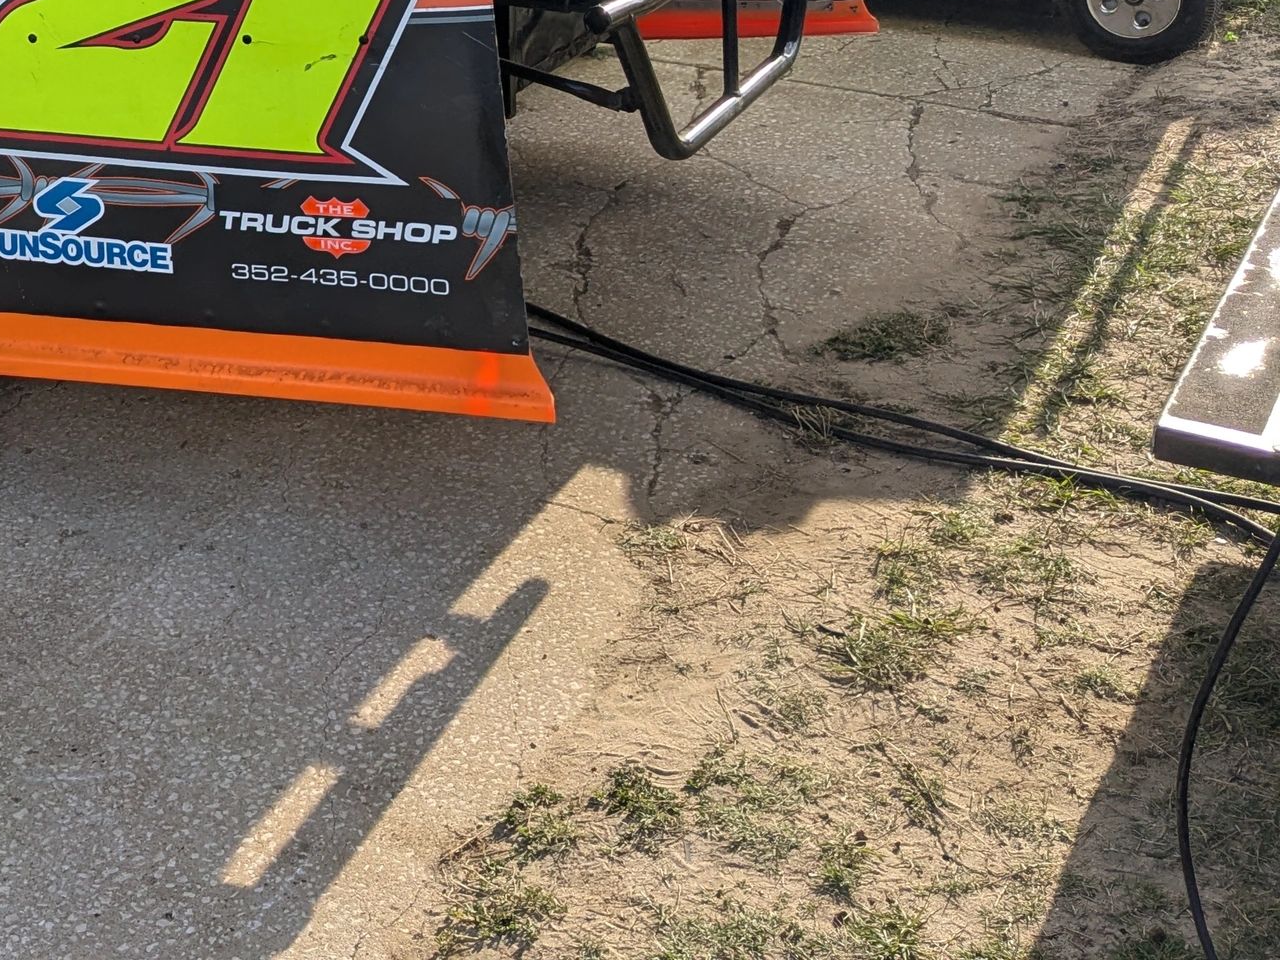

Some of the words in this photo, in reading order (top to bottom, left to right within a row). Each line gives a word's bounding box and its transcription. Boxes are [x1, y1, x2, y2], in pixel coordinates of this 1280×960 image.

[315, 203, 355, 216] THE
[219, 210, 342, 237] TRUCK
[351, 219, 458, 244] SHOP
[320, 239, 357, 251] INC.
[231, 262, 450, 296] 352-435-0000
